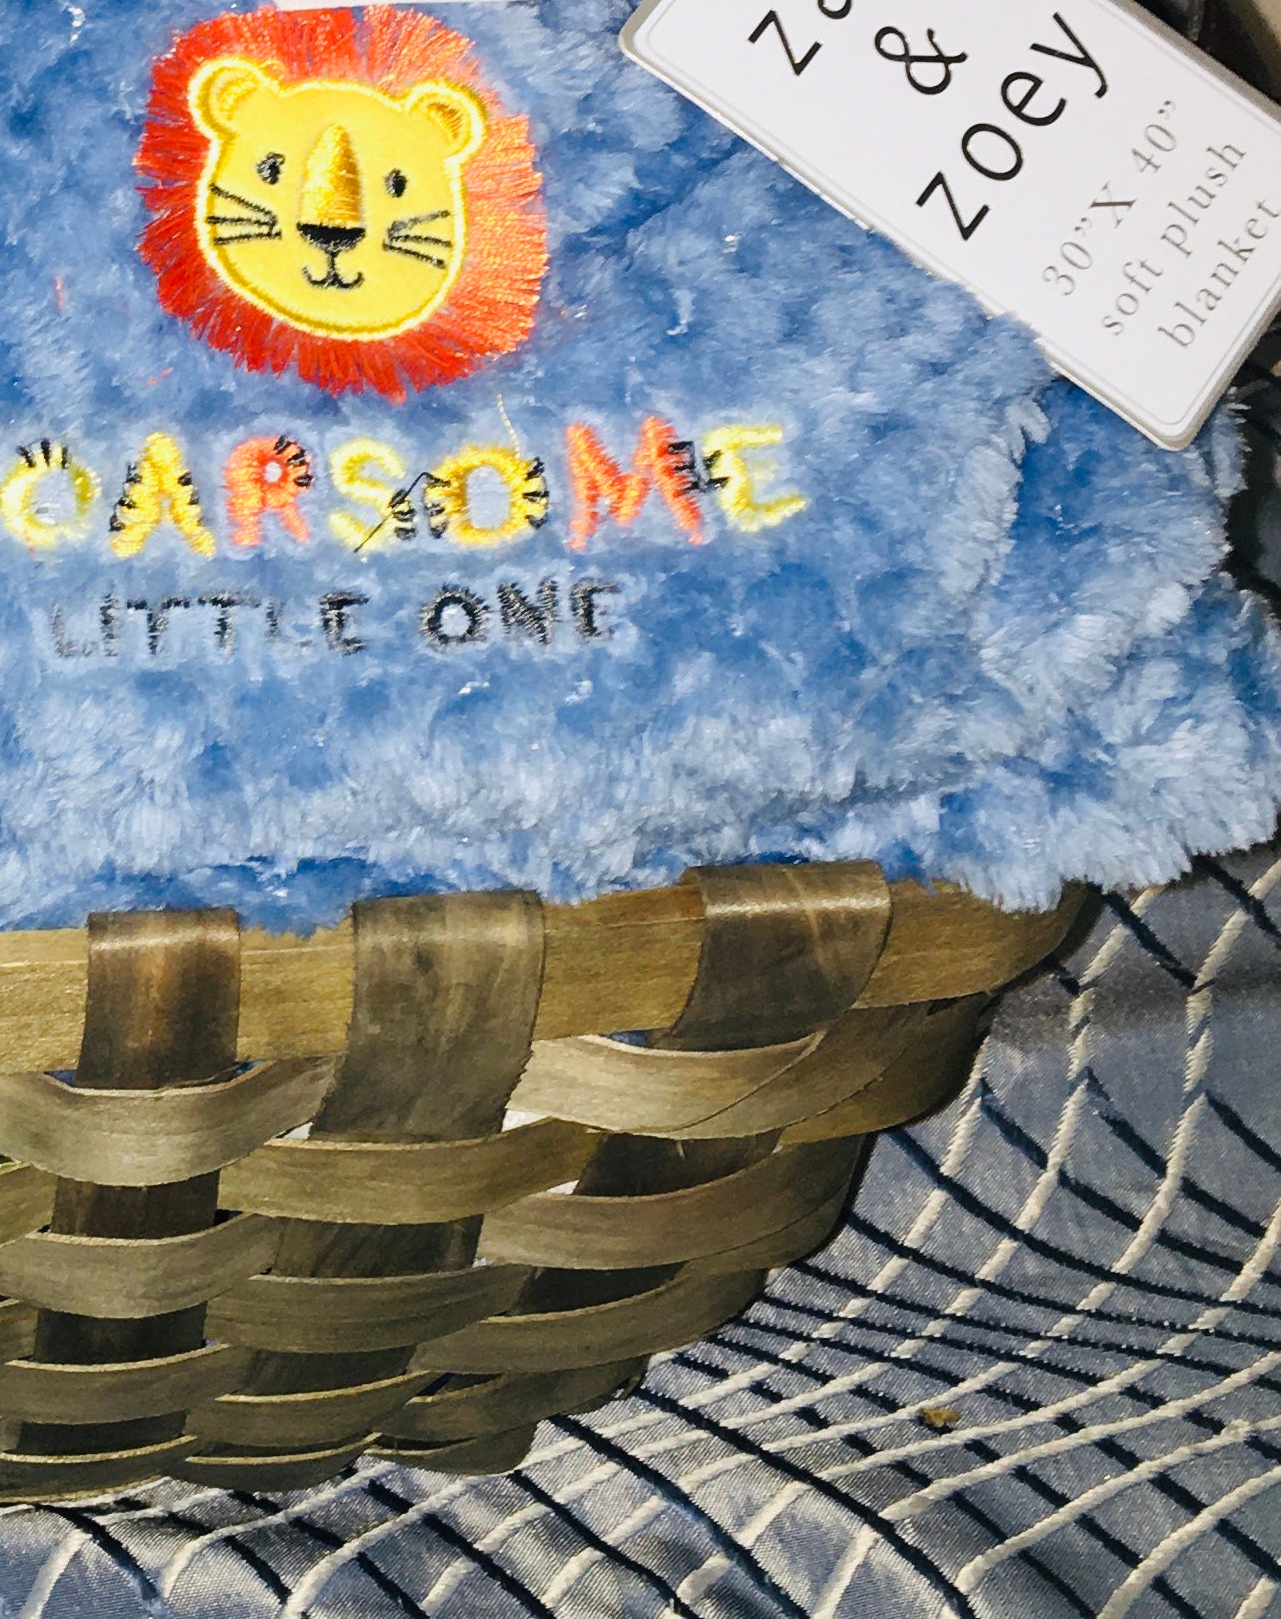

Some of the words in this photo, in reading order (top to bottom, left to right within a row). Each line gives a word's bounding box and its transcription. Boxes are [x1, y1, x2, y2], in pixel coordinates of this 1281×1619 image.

[873, 25, 969, 96] &
[915, 11, 1109, 242] zoey
[1102, 258, 1165, 337] soft
[1159, 143, 1248, 259] plush
[1157, 197, 1281, 350] blanket
[51, 589, 370, 658] LITTLE
[419, 577, 622, 653] ONE
